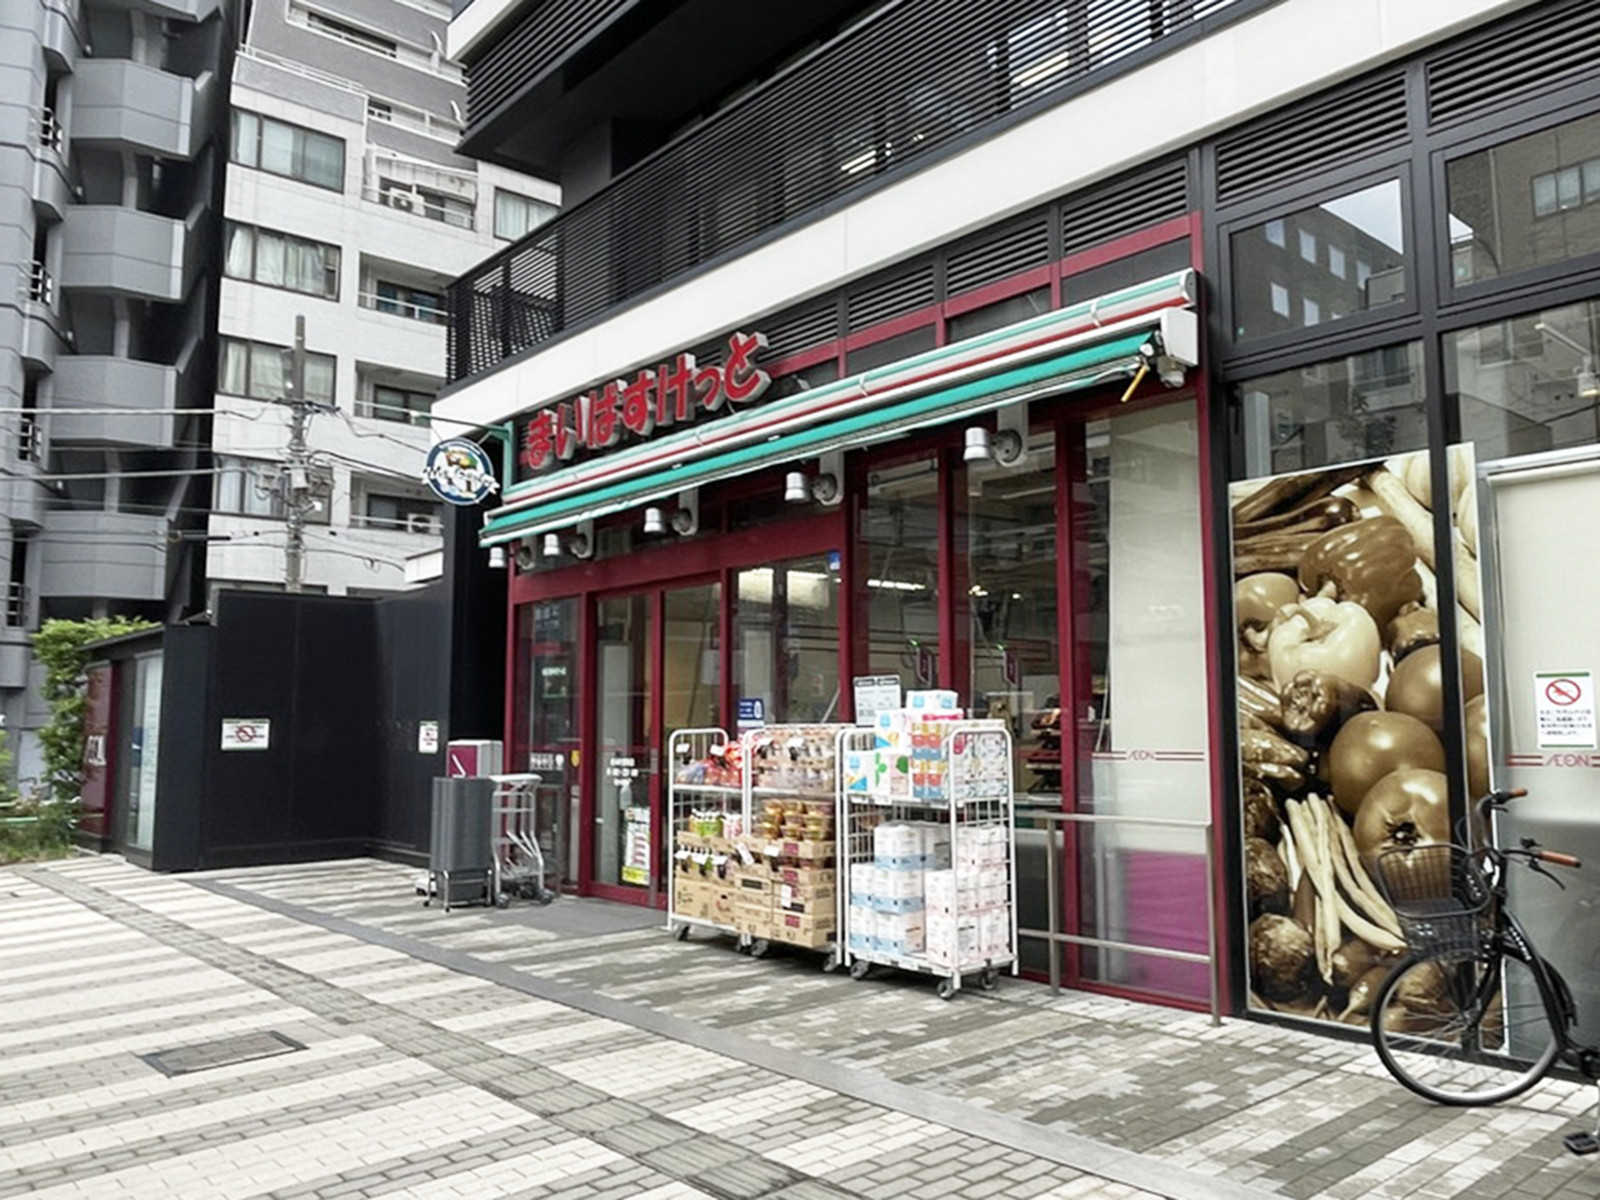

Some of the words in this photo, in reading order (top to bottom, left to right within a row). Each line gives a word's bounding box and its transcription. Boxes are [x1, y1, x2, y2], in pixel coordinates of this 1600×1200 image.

[527, 331, 771, 470] まいばすけっと
